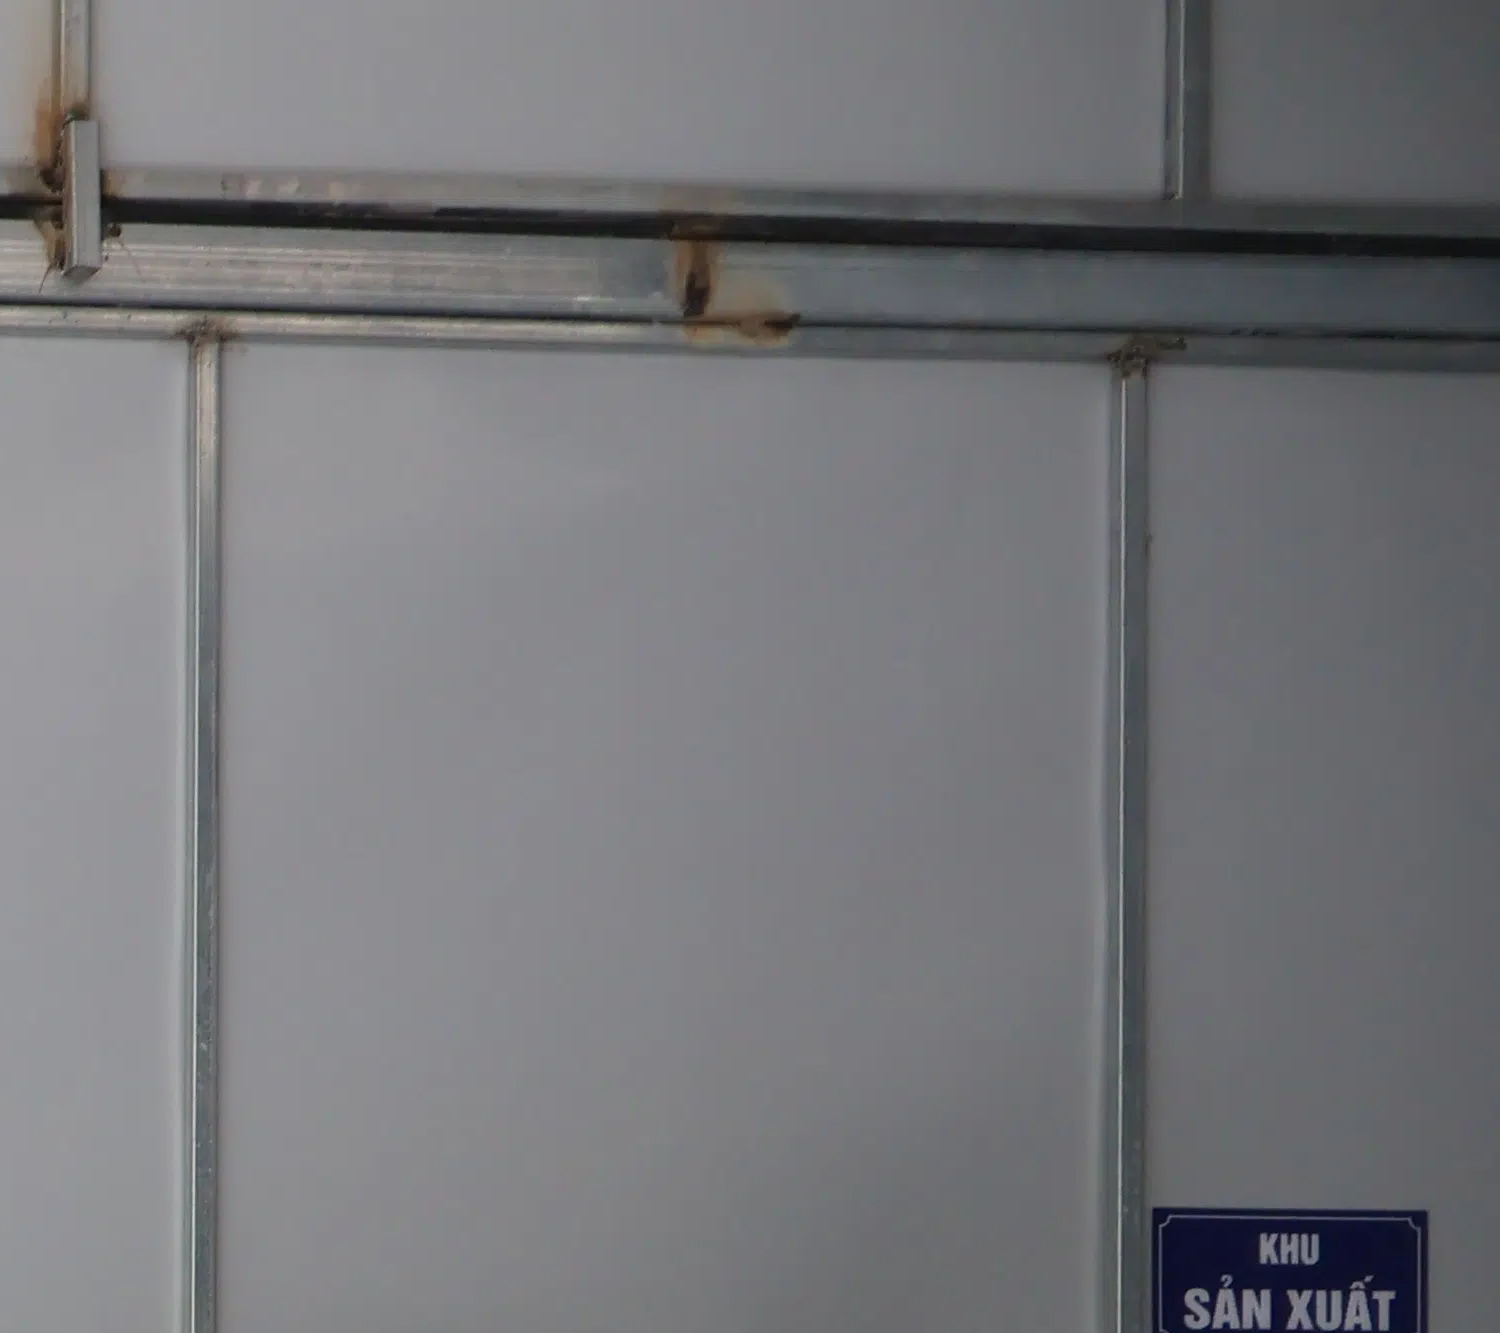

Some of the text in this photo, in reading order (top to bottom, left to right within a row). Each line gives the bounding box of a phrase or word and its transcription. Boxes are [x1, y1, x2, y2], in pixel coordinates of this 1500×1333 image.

[1259, 1233, 1320, 1265] KHU
[1184, 1275, 1396, 1331] SẢN XUẤT
